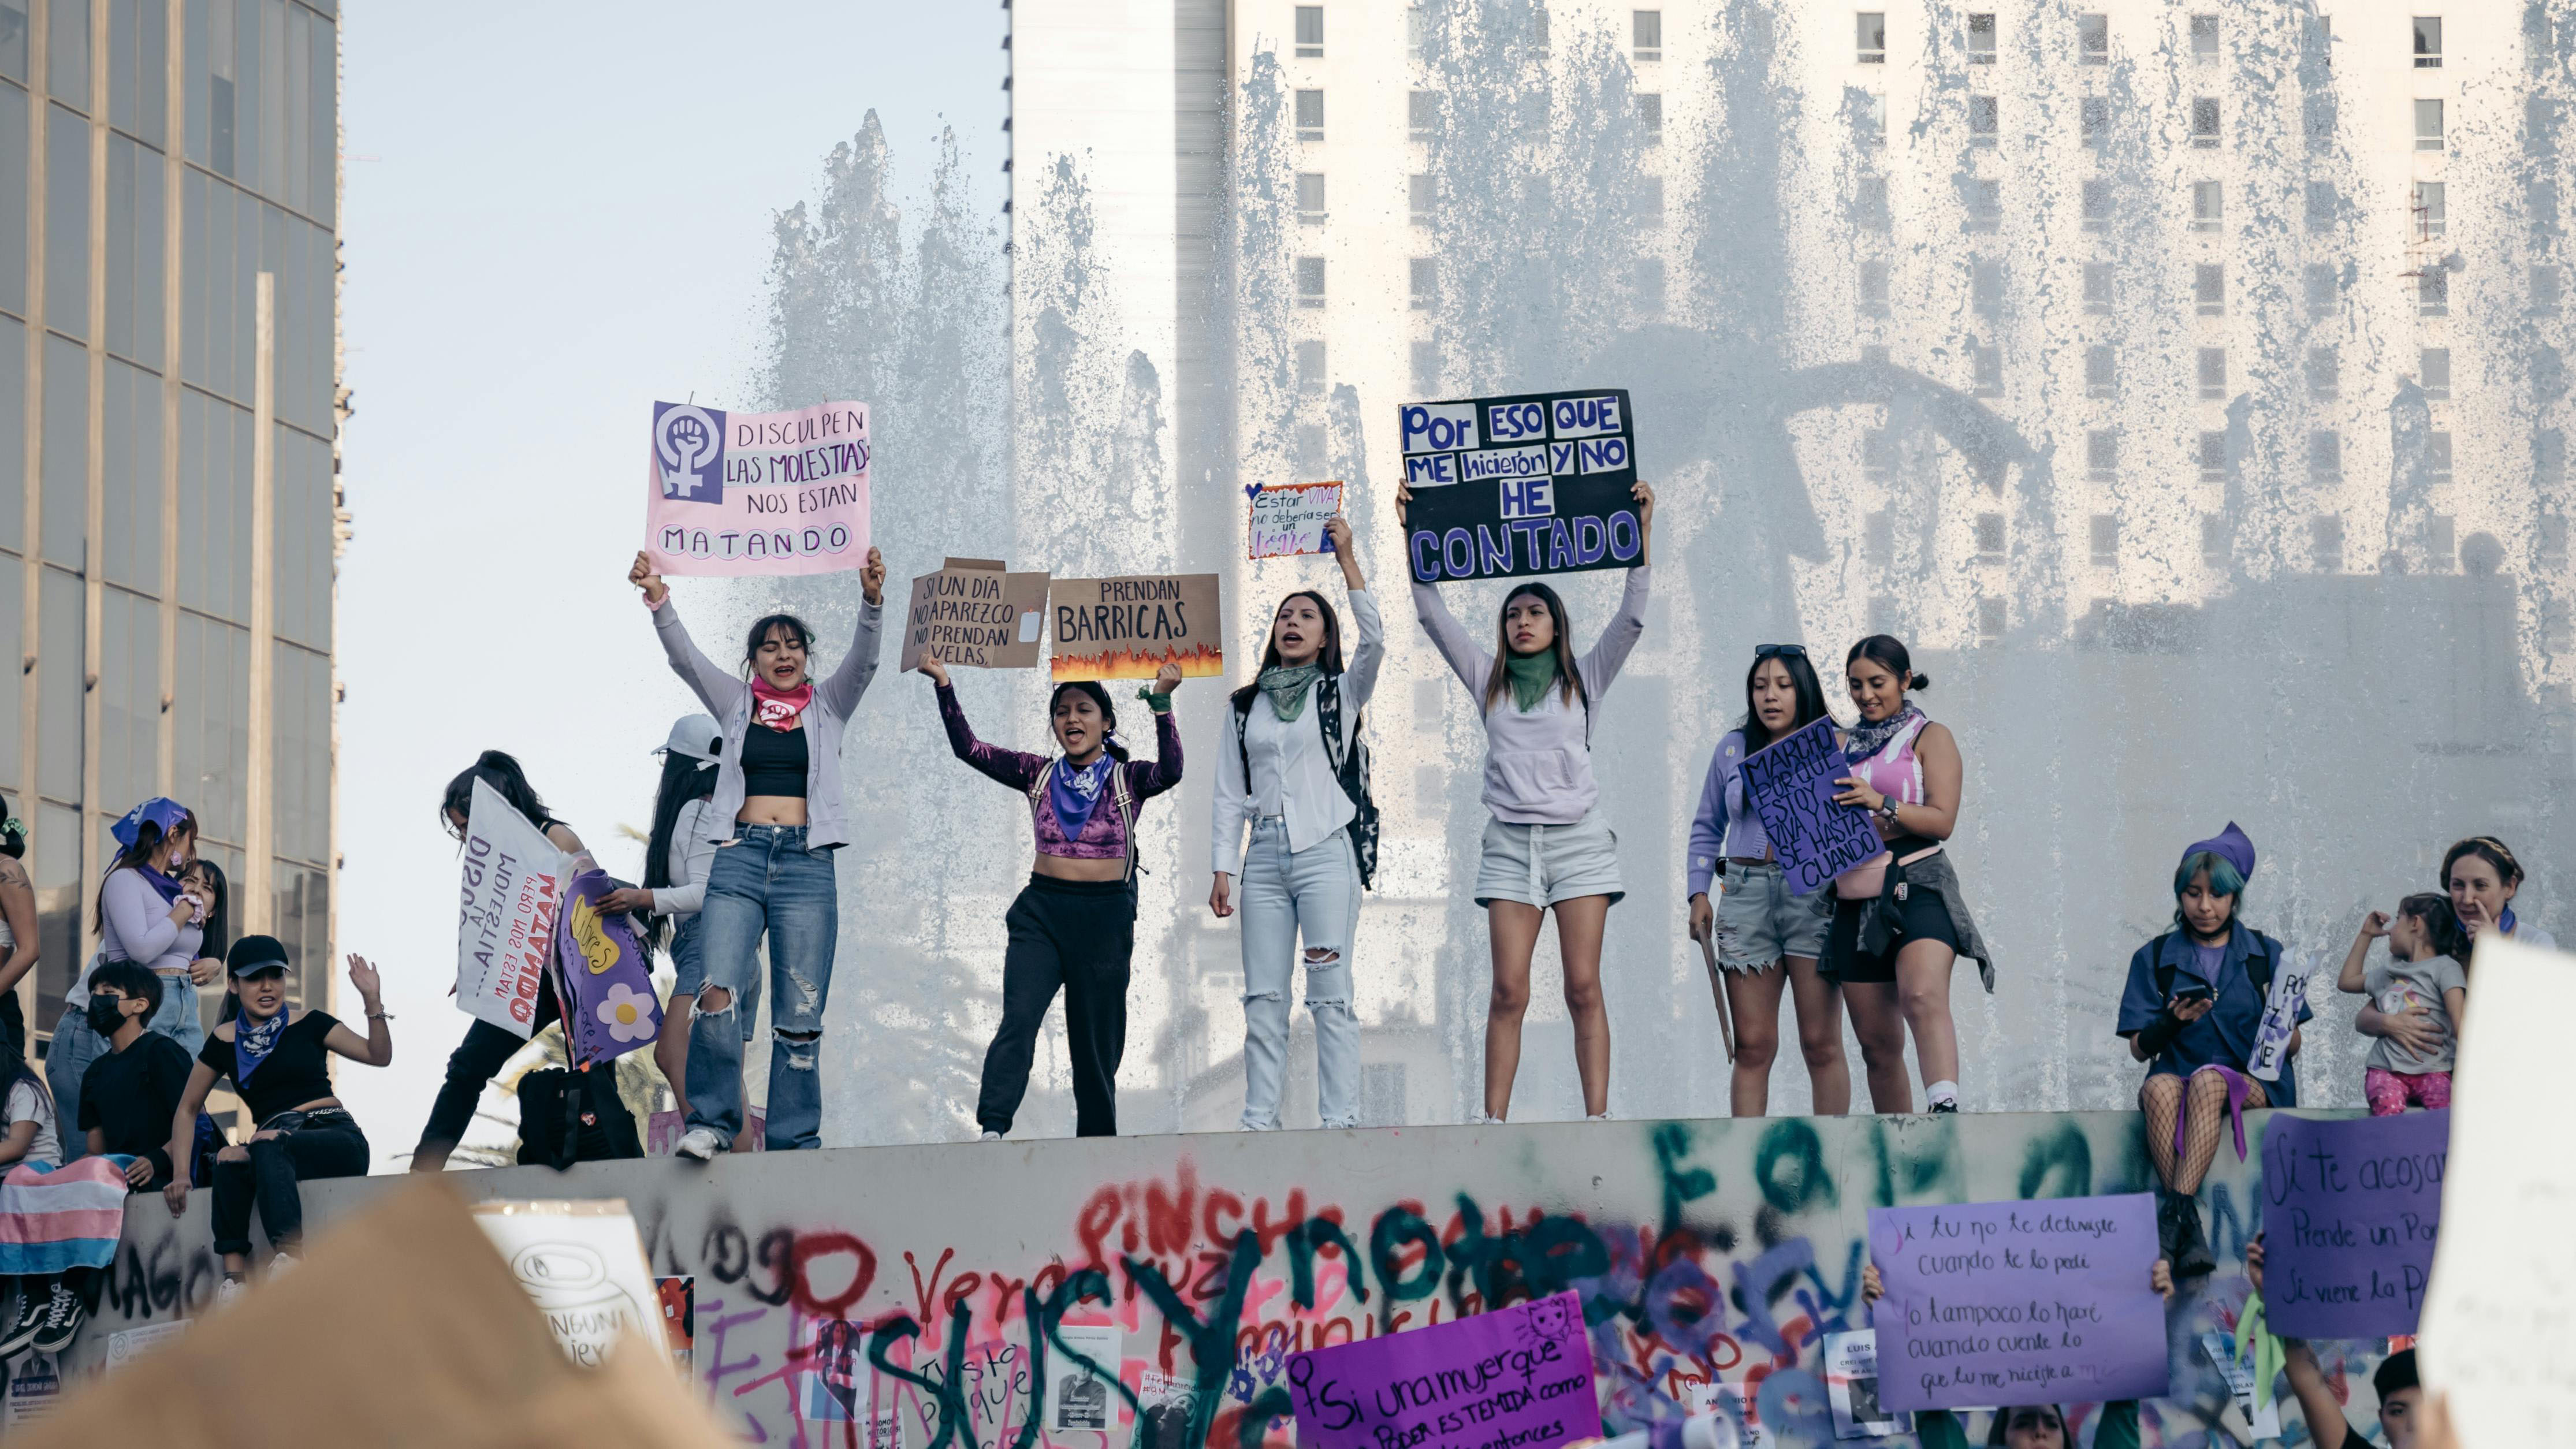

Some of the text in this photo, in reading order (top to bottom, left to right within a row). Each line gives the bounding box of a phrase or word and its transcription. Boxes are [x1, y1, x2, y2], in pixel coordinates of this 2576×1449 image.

[738, 411, 863, 446] DISCULPEN
[1402, 396, 1619, 451] Por ESO QUE
[727, 439, 868, 484] LAS MOLESTIAS
[1408, 453, 1454, 483] ME
[1580, 439, 1626, 472] NO
[747, 483, 857, 513] NOS ESTAN
[1255, 487, 1334, 508] Estar VIVA
[1502, 480, 1551, 516] HE
[1251, 514, 1268, 527] no
[1316, 512, 1337, 520] ser
[1282, 522, 1296, 531] un
[665, 526, 846, 554] MATANDO
[1410, 510, 1640, 581] CONTADO
[923, 576, 1000, 600] SI UN DÍA
[1100, 579, 1180, 602] PRENDAN
[913, 604, 929, 626] NO
[1058, 601, 1187, 642] BARRICAS
[913, 625, 1010, 647] NO PRENDAN
[930, 644, 989, 666] VELAS,
[1744, 724, 1833, 788] MARCHO
[1758, 780, 1819, 830] ESTOY
[1767, 817, 1808, 848] VIVA
[1806, 803, 1821, 828] Y
[1779, 810, 1869, 870] SE HASTA
[1801, 831, 1877, 888] CUANDO
[2268, 1133, 2305, 1206] Si
[2307, 1137, 2347, 1192] te
[1970, 1223, 1998, 1245] no
[2290, 1207, 2357, 1248] Prende
[2370, 1225, 2398, 1246] un
[1918, 1250, 1994, 1276] cuando
[2030, 1249, 2048, 1269] lo
[2283, 1268, 2310, 1305] Si
[2314, 1284, 2361, 1303] viene
[2371, 1270, 2396, 1298] la
[1930, 1296, 2022, 1327] tampoco
[2028, 1301, 2050, 1323] lo
[1847, 1344, 1871, 1353] LUIS
[1908, 1336, 1990, 1359] cuando
[2061, 1331, 2082, 1349] lo
[1320, 1380, 1365, 1431] Si
[1375, 1374, 1438, 1418] una
[1436, 1349, 1512, 1398] mujer
[1461, 1385, 1536, 1424] TEMIDA
[1540, 1374, 1586, 1400] como
[1920, 1370, 1949, 1399] que
